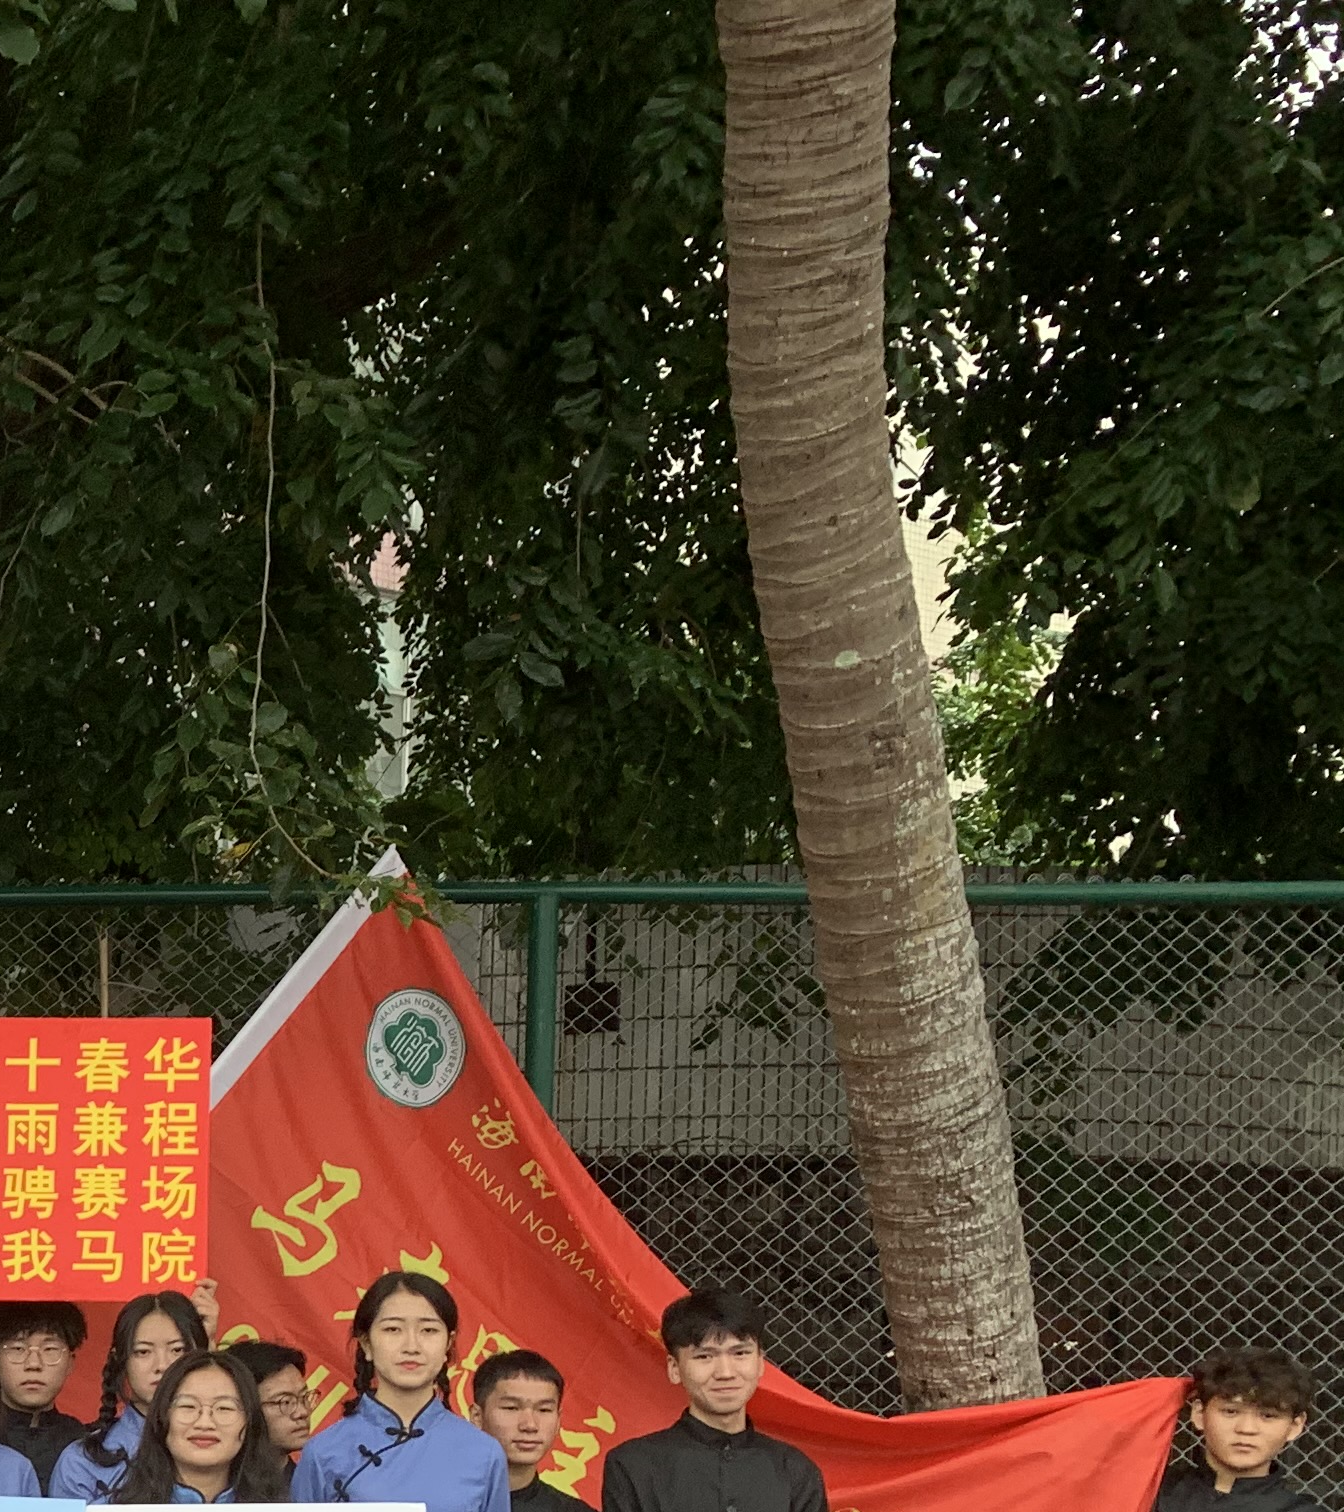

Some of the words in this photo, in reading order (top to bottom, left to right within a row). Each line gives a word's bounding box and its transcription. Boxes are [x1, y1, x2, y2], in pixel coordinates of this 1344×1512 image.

[379, 997, 411, 1024] HAINAN
[414, 997, 452, 1026] NORMAL
[447, 1137, 523, 1215] HAINAN
[520, 1210, 605, 1292] NORMAL
